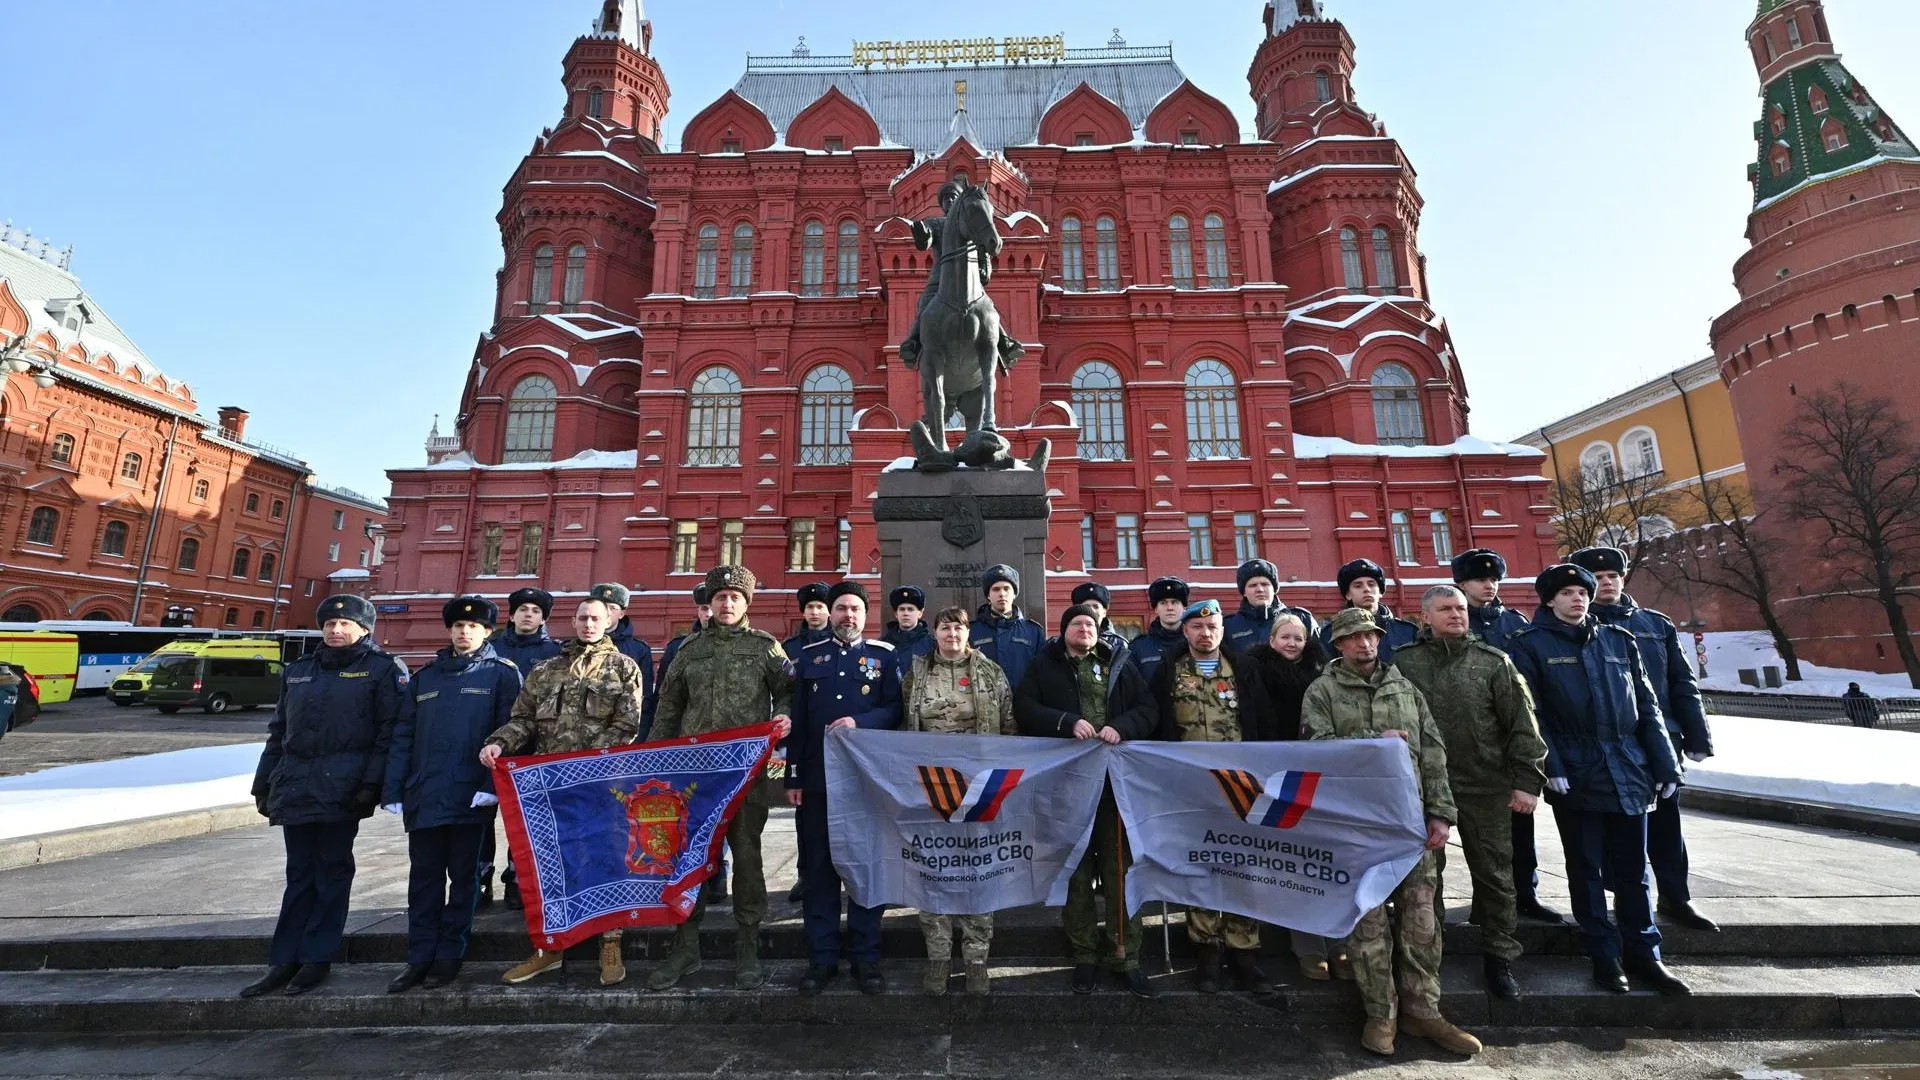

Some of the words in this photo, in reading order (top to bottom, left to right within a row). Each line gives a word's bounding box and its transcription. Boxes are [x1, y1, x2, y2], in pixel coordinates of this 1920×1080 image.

[935, 576, 982, 588] ЖУКОВ
[911, 830, 1022, 850] Ассоциация
[1203, 829, 1333, 864] Ассоциация
[901, 848, 992, 872] ветеранов
[997, 845, 1034, 861] СВО
[1188, 849, 1297, 874] ветеранов
[1303, 863, 1350, 885] СВО
[919, 871, 977, 883] Московской
[979, 865, 1015, 882] области
[1211, 866, 1277, 886] Московской
[1279, 880, 1325, 897] области
